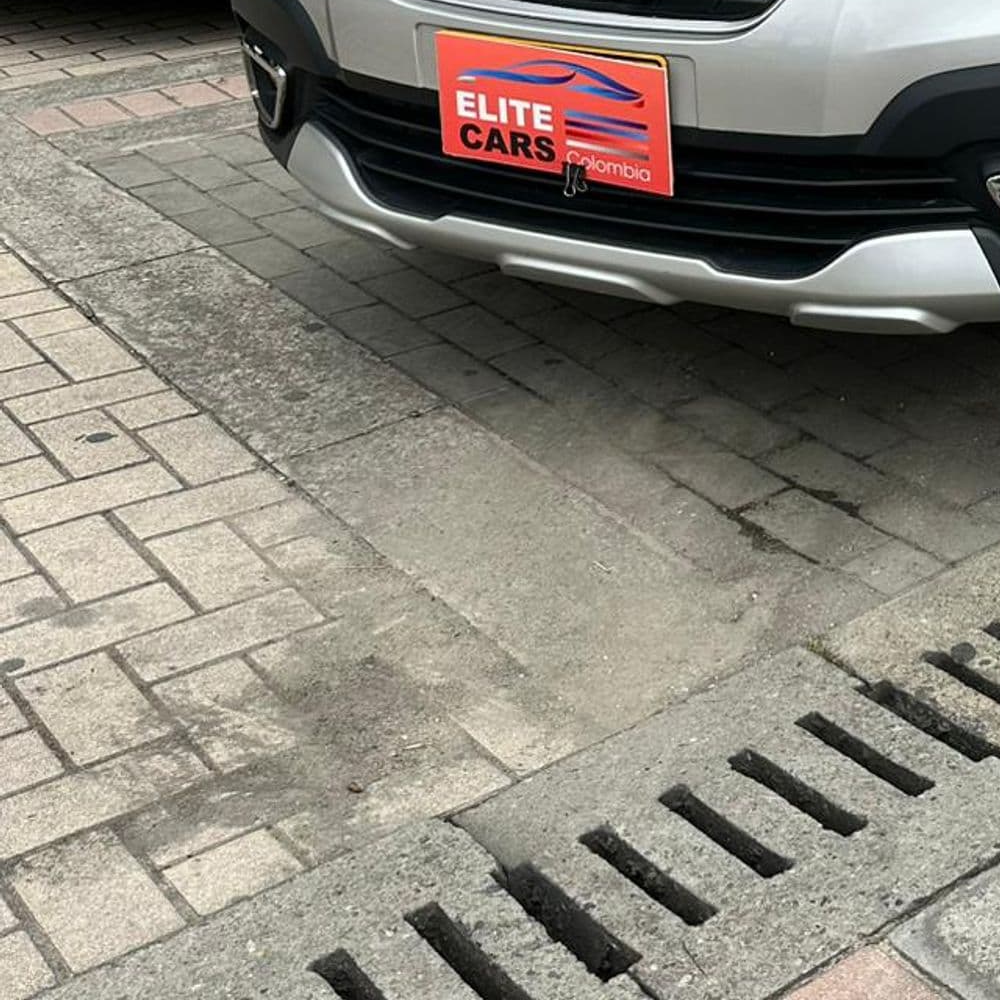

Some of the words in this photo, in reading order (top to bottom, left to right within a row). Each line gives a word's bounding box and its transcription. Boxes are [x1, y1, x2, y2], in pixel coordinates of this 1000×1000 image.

[456, 89, 554, 132] ELITE
[459, 123, 556, 163] CARS
[566, 150, 651, 182] Colombia
